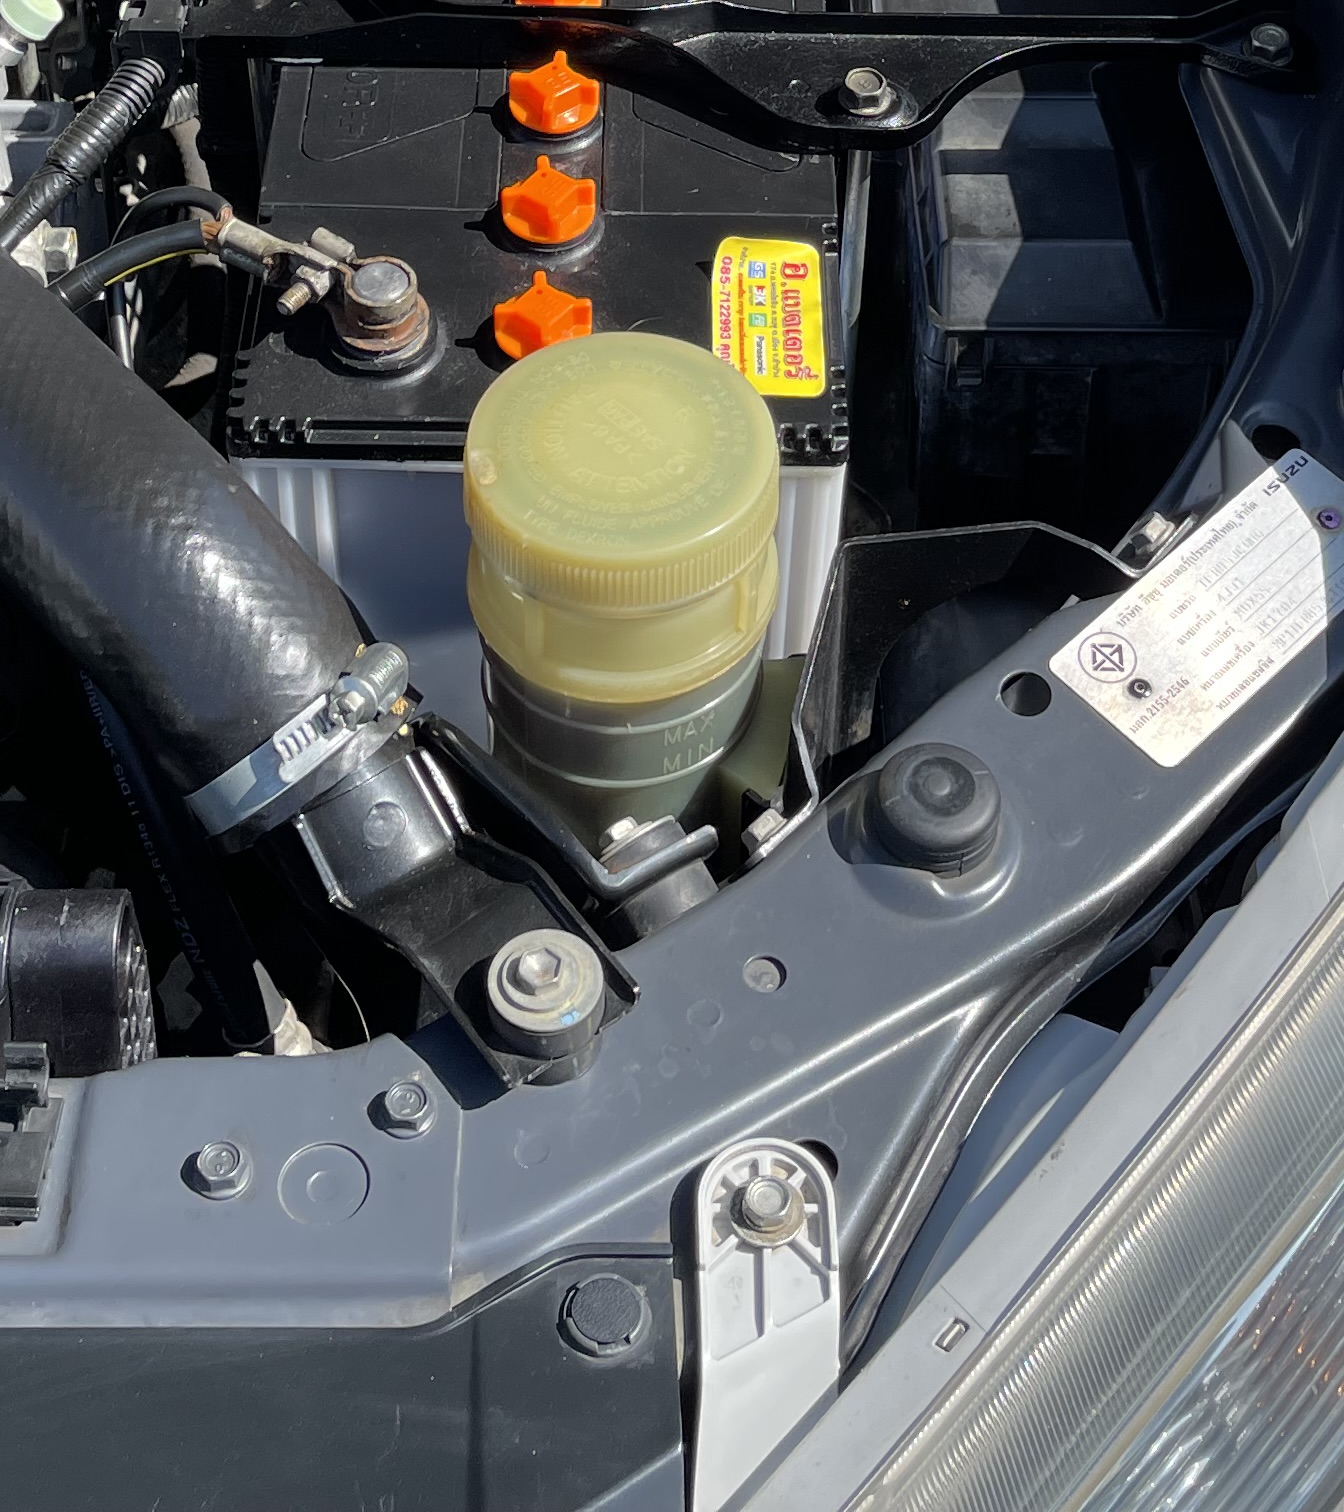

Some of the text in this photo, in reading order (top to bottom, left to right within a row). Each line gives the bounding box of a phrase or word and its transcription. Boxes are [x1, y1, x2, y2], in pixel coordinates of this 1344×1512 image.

[754, 261, 764, 278] GS
[720, 256, 733, 340] 085-7122993
[756, 335, 765, 375] Panasonic
[567, 449, 697, 492] ATTENTION
[1263, 456, 1309, 496] ISUZU
[1127, 676, 1191, 734] มอก.2155-2546
[664, 710, 715, 747] MAX
[663, 738, 714, 774] MIN
